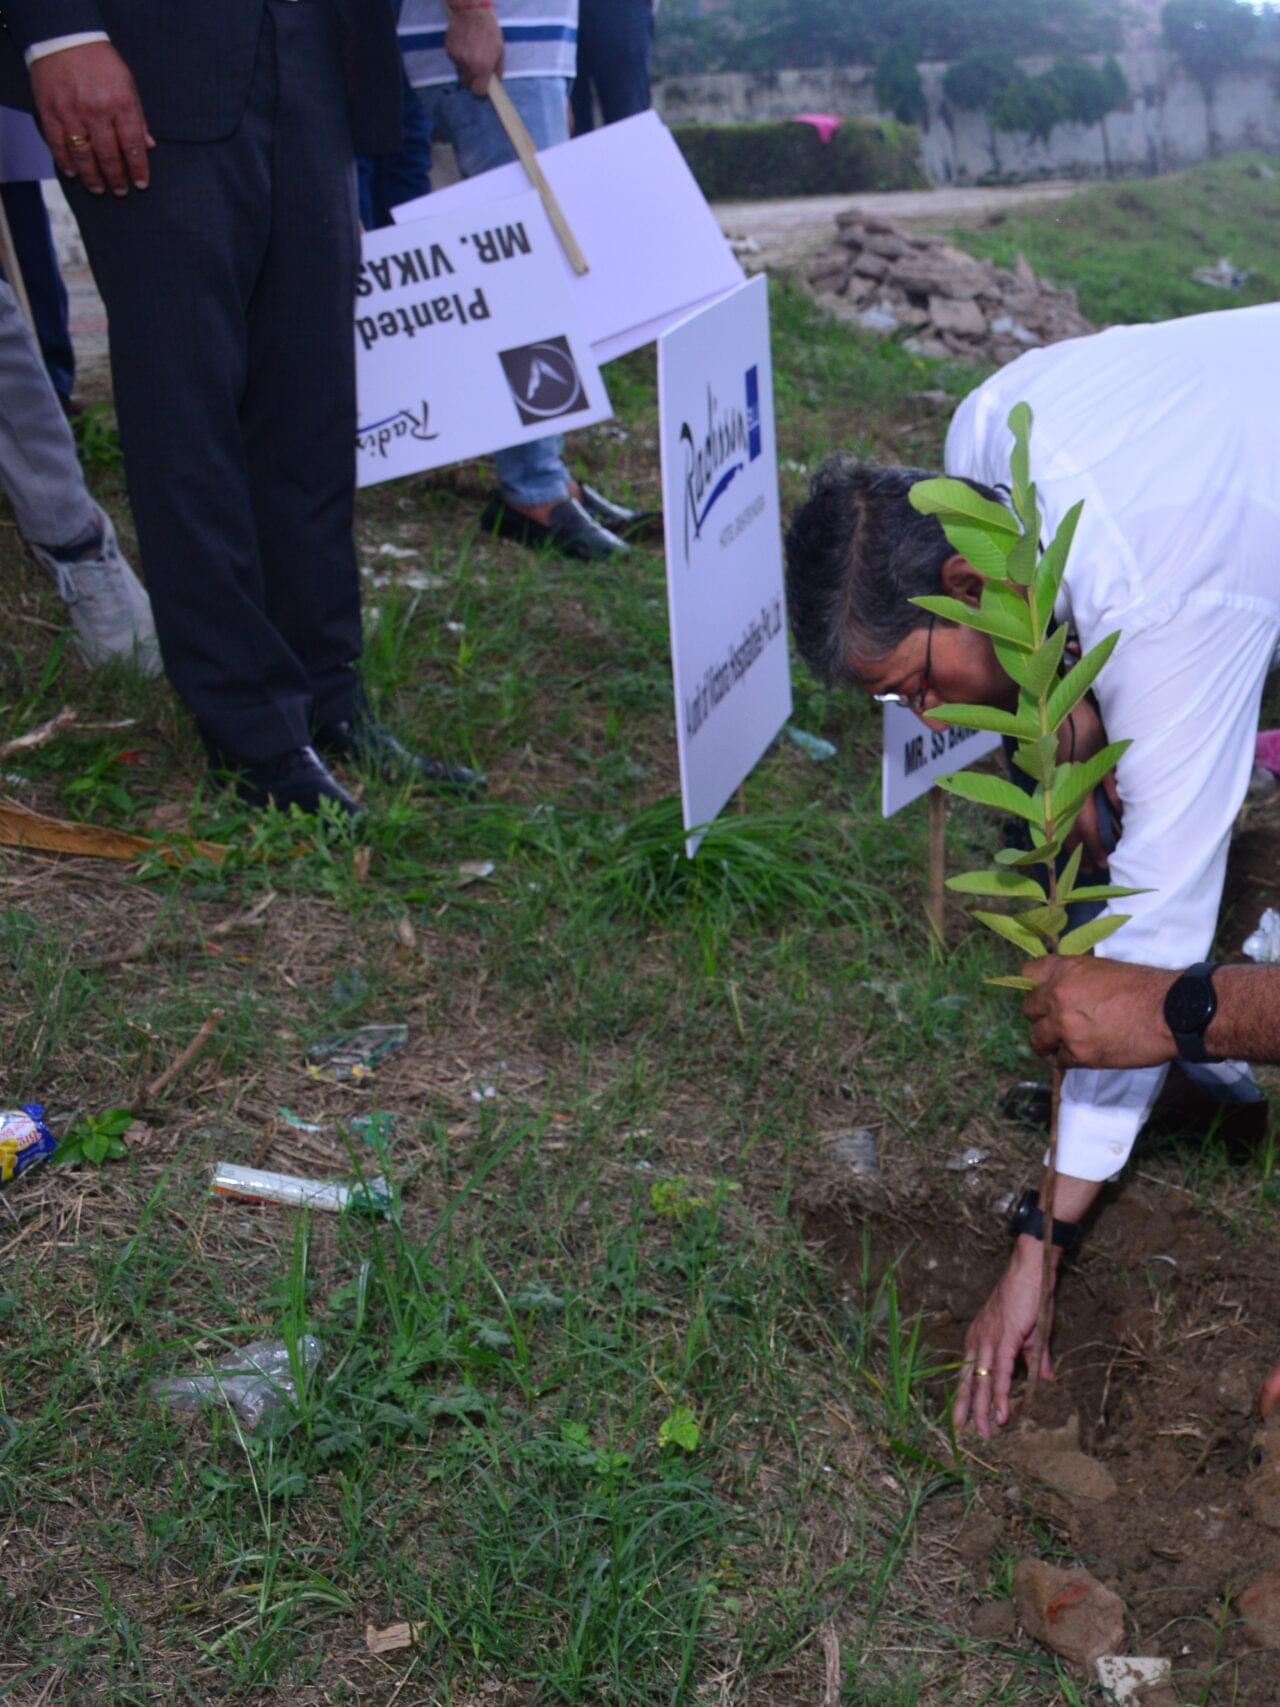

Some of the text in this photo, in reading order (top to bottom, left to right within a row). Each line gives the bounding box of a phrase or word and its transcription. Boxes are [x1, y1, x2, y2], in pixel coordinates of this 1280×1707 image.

[355, 222, 532, 298] MR. VIKAS
[355, 287, 491, 351] Planted
[904, 735, 928, 777] MR.
